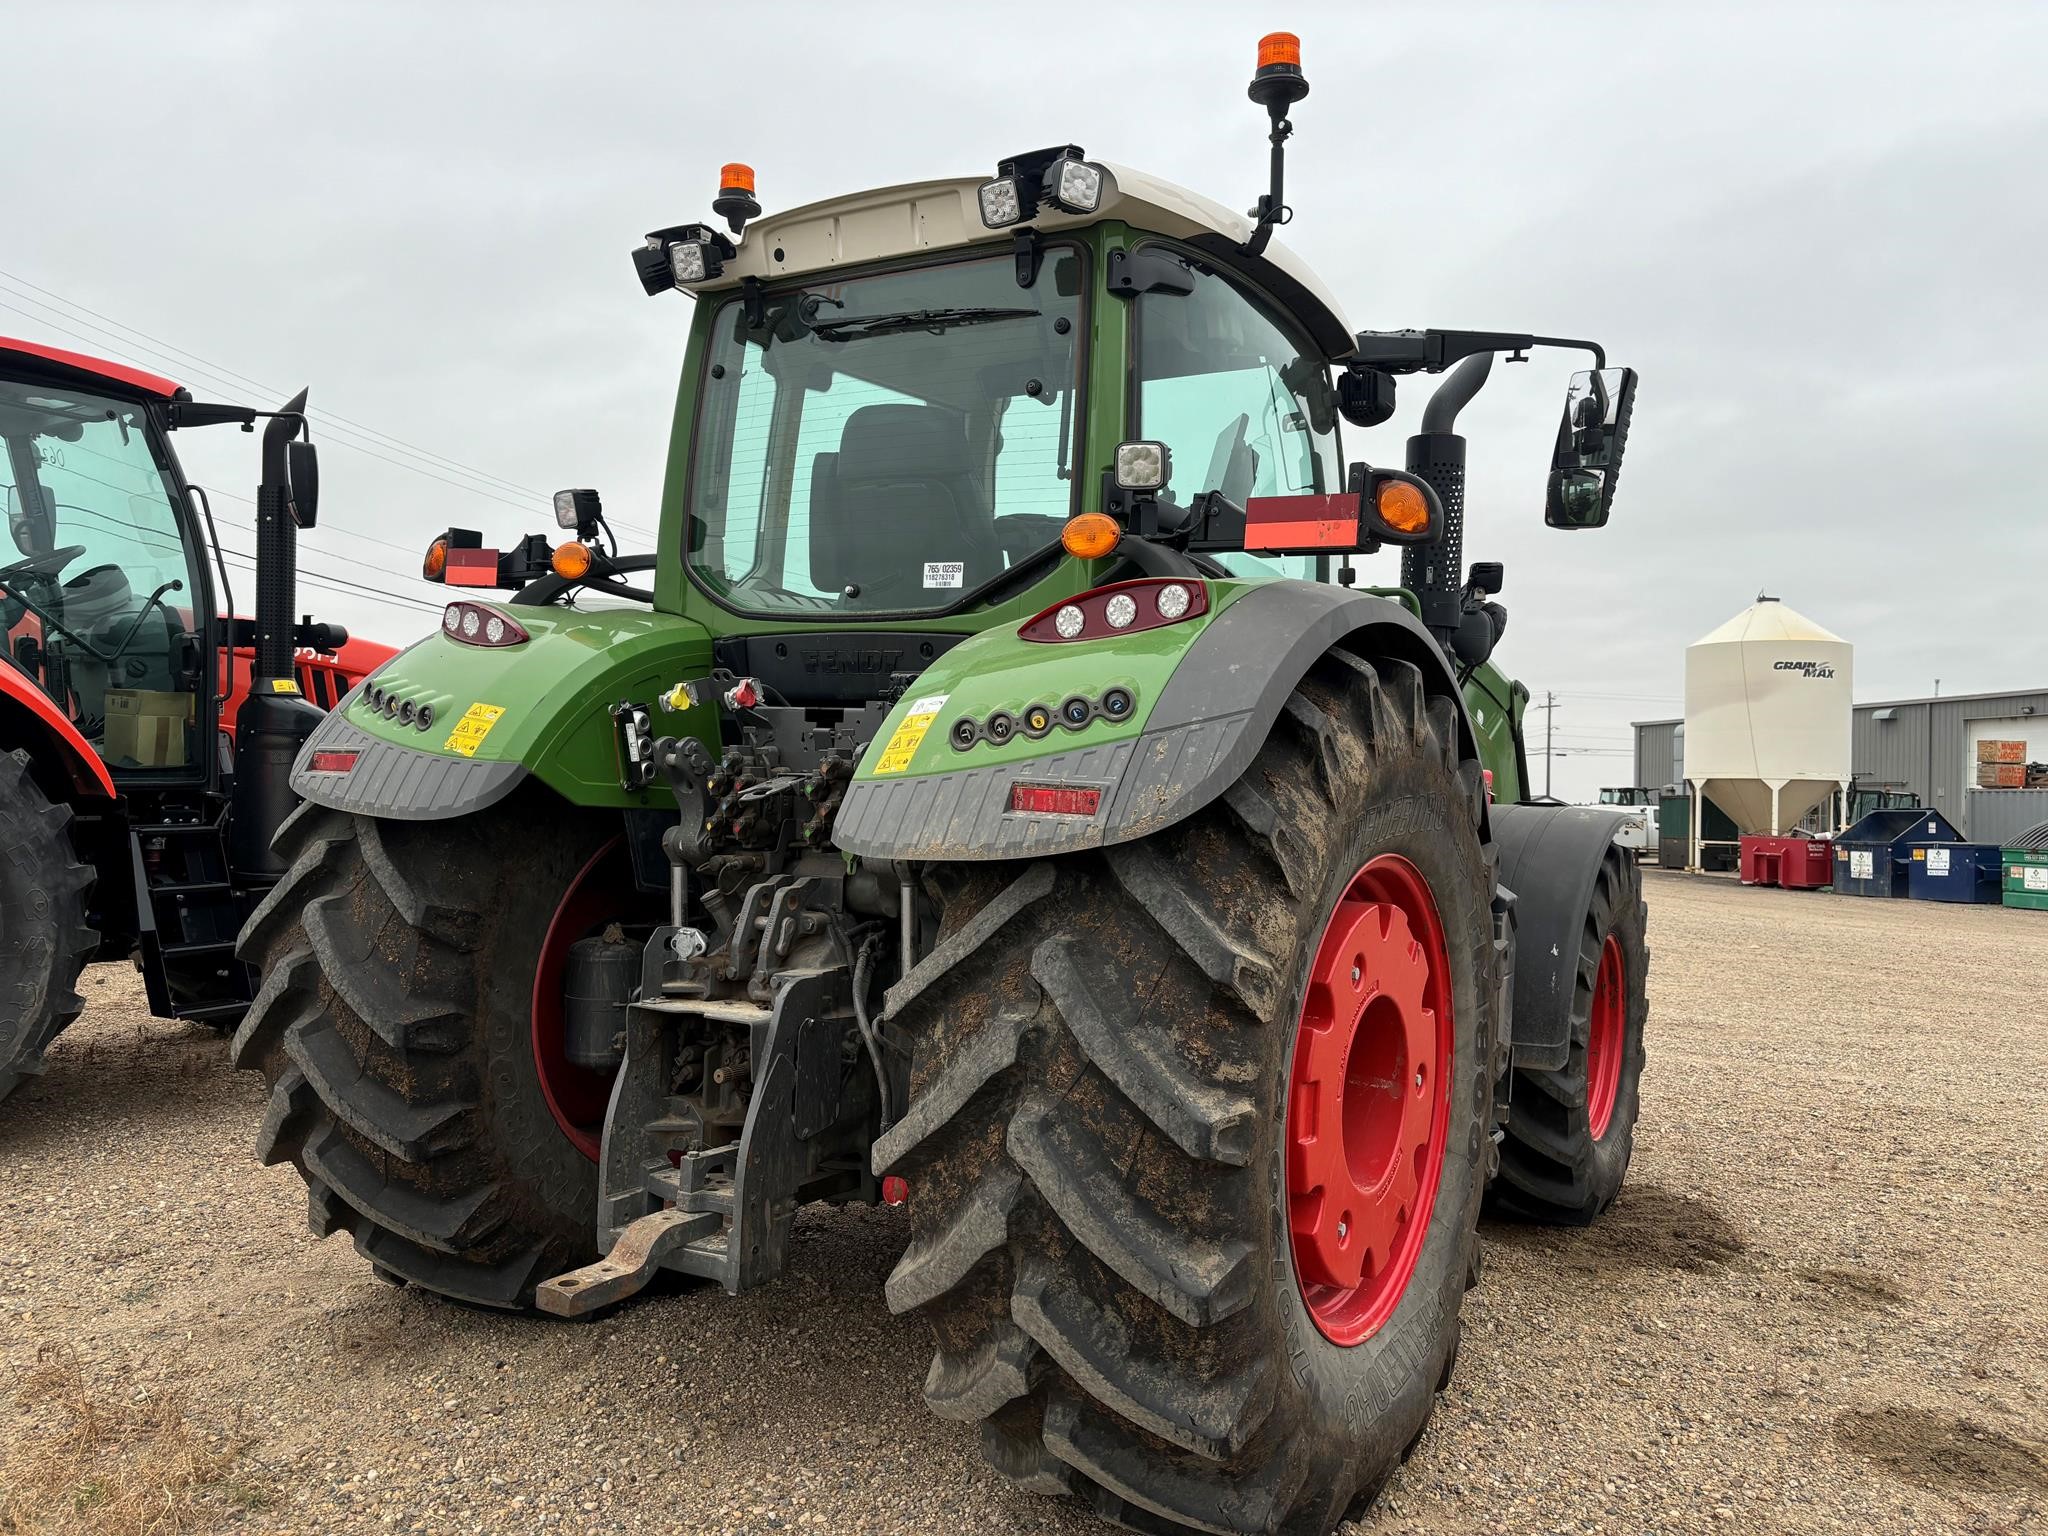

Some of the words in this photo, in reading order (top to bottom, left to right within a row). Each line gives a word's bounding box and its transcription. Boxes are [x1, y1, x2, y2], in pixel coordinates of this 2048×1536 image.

[800, 649, 905, 676] FENDT
[1773, 661, 1817, 670] GRAIN
[1803, 668, 1835, 679] MAX
[1344, 1288, 1450, 1441] TRELLEBORG
